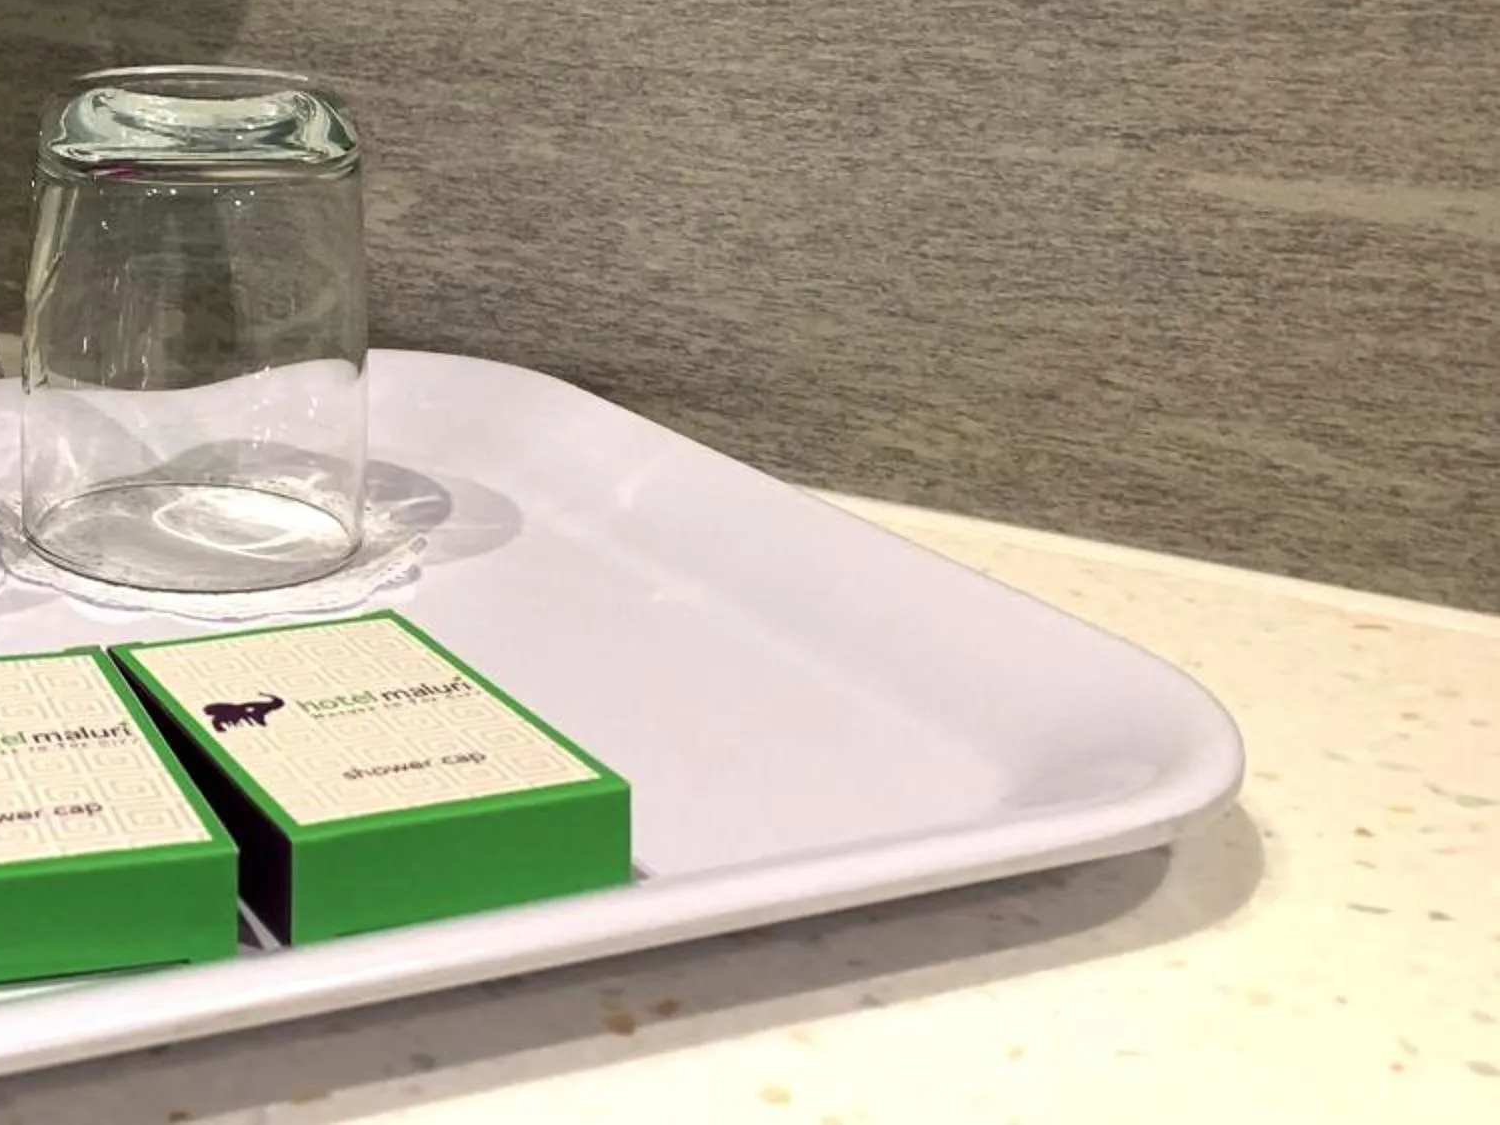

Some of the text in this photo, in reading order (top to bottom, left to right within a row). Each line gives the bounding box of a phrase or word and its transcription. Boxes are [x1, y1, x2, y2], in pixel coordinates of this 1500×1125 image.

[297, 690, 378, 713] hotel
[381, 676, 473, 702] maluri
[32, 720, 133, 744] maluri
[343, 750, 486, 780] shower cap
[53, 801, 104, 817] cap
